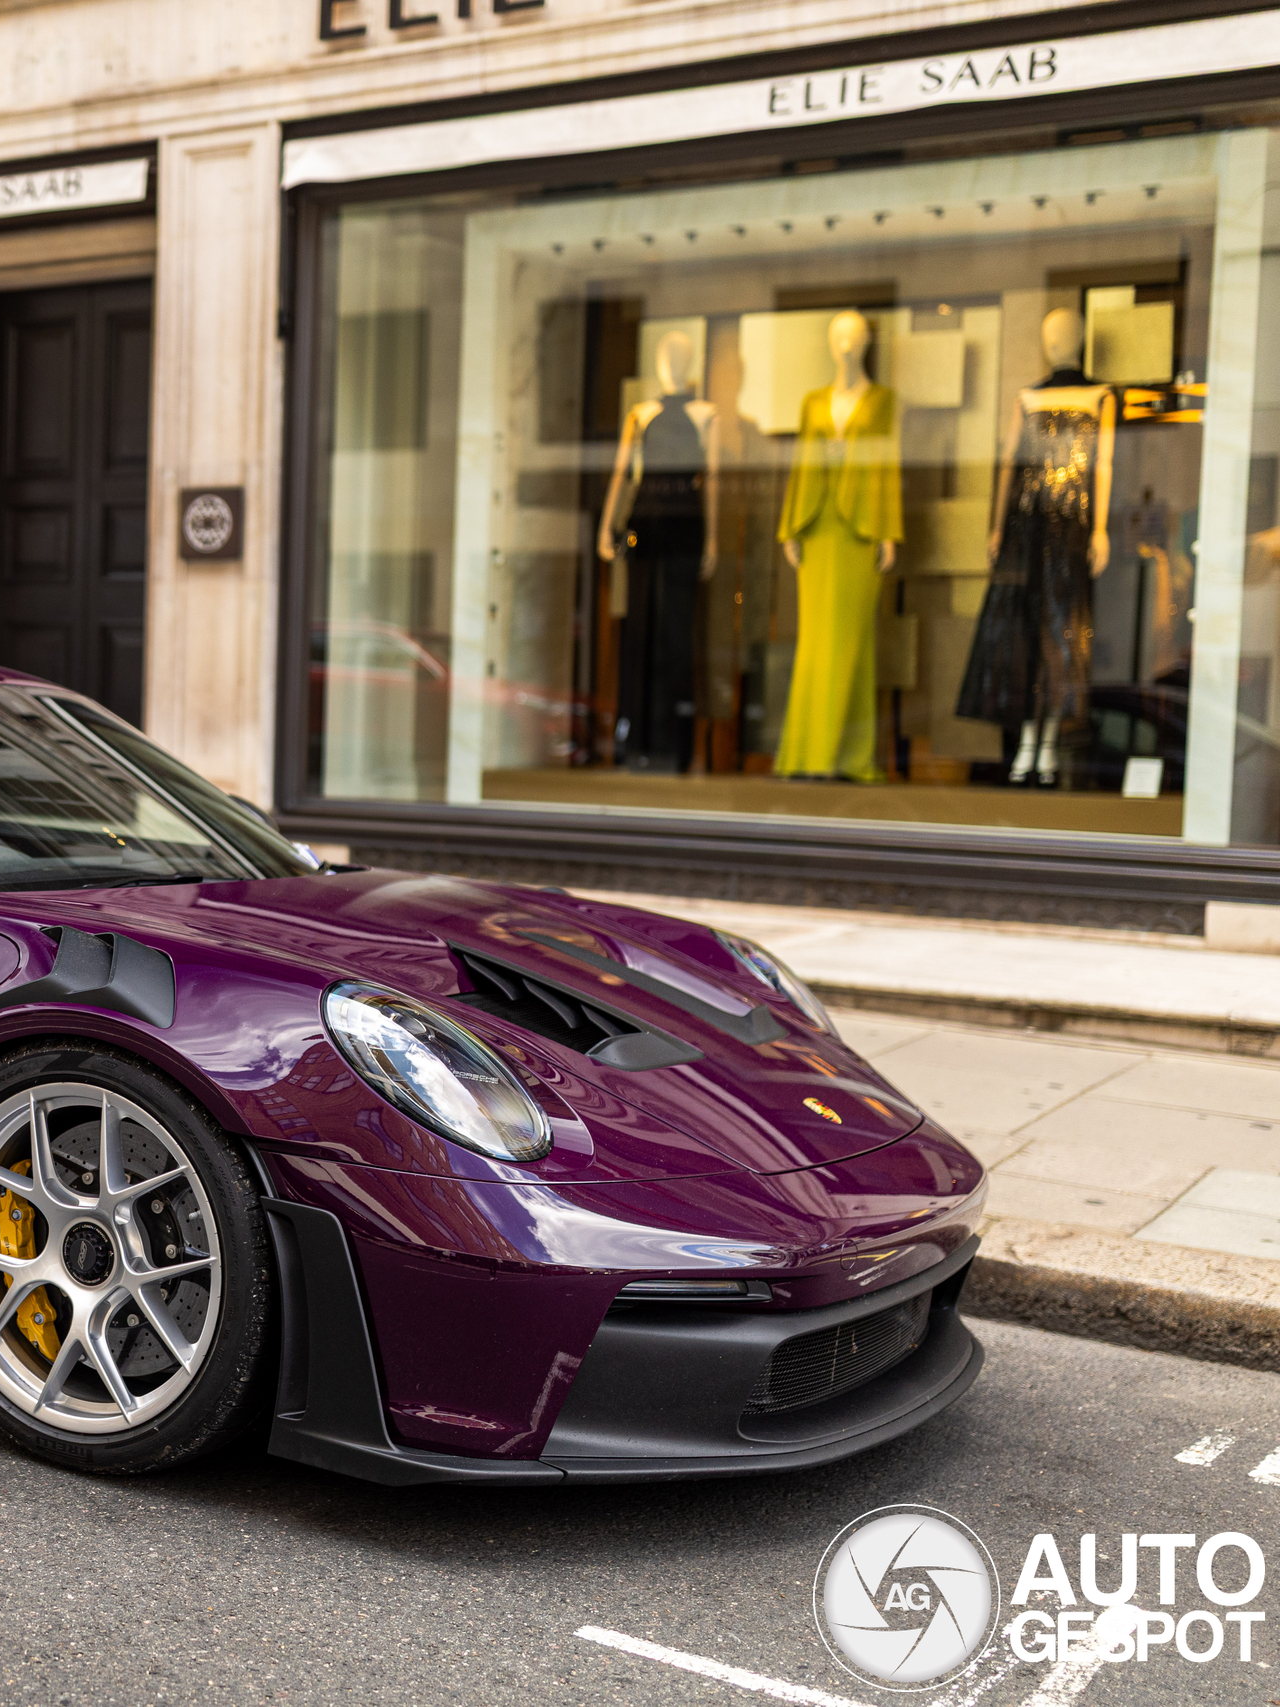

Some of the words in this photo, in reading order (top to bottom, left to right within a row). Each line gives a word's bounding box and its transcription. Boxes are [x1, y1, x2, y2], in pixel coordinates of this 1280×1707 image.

[767, 66, 885, 115] ELIE
[920, 46, 1058, 94] SAAB
[0, 167, 83, 206] SAAB
